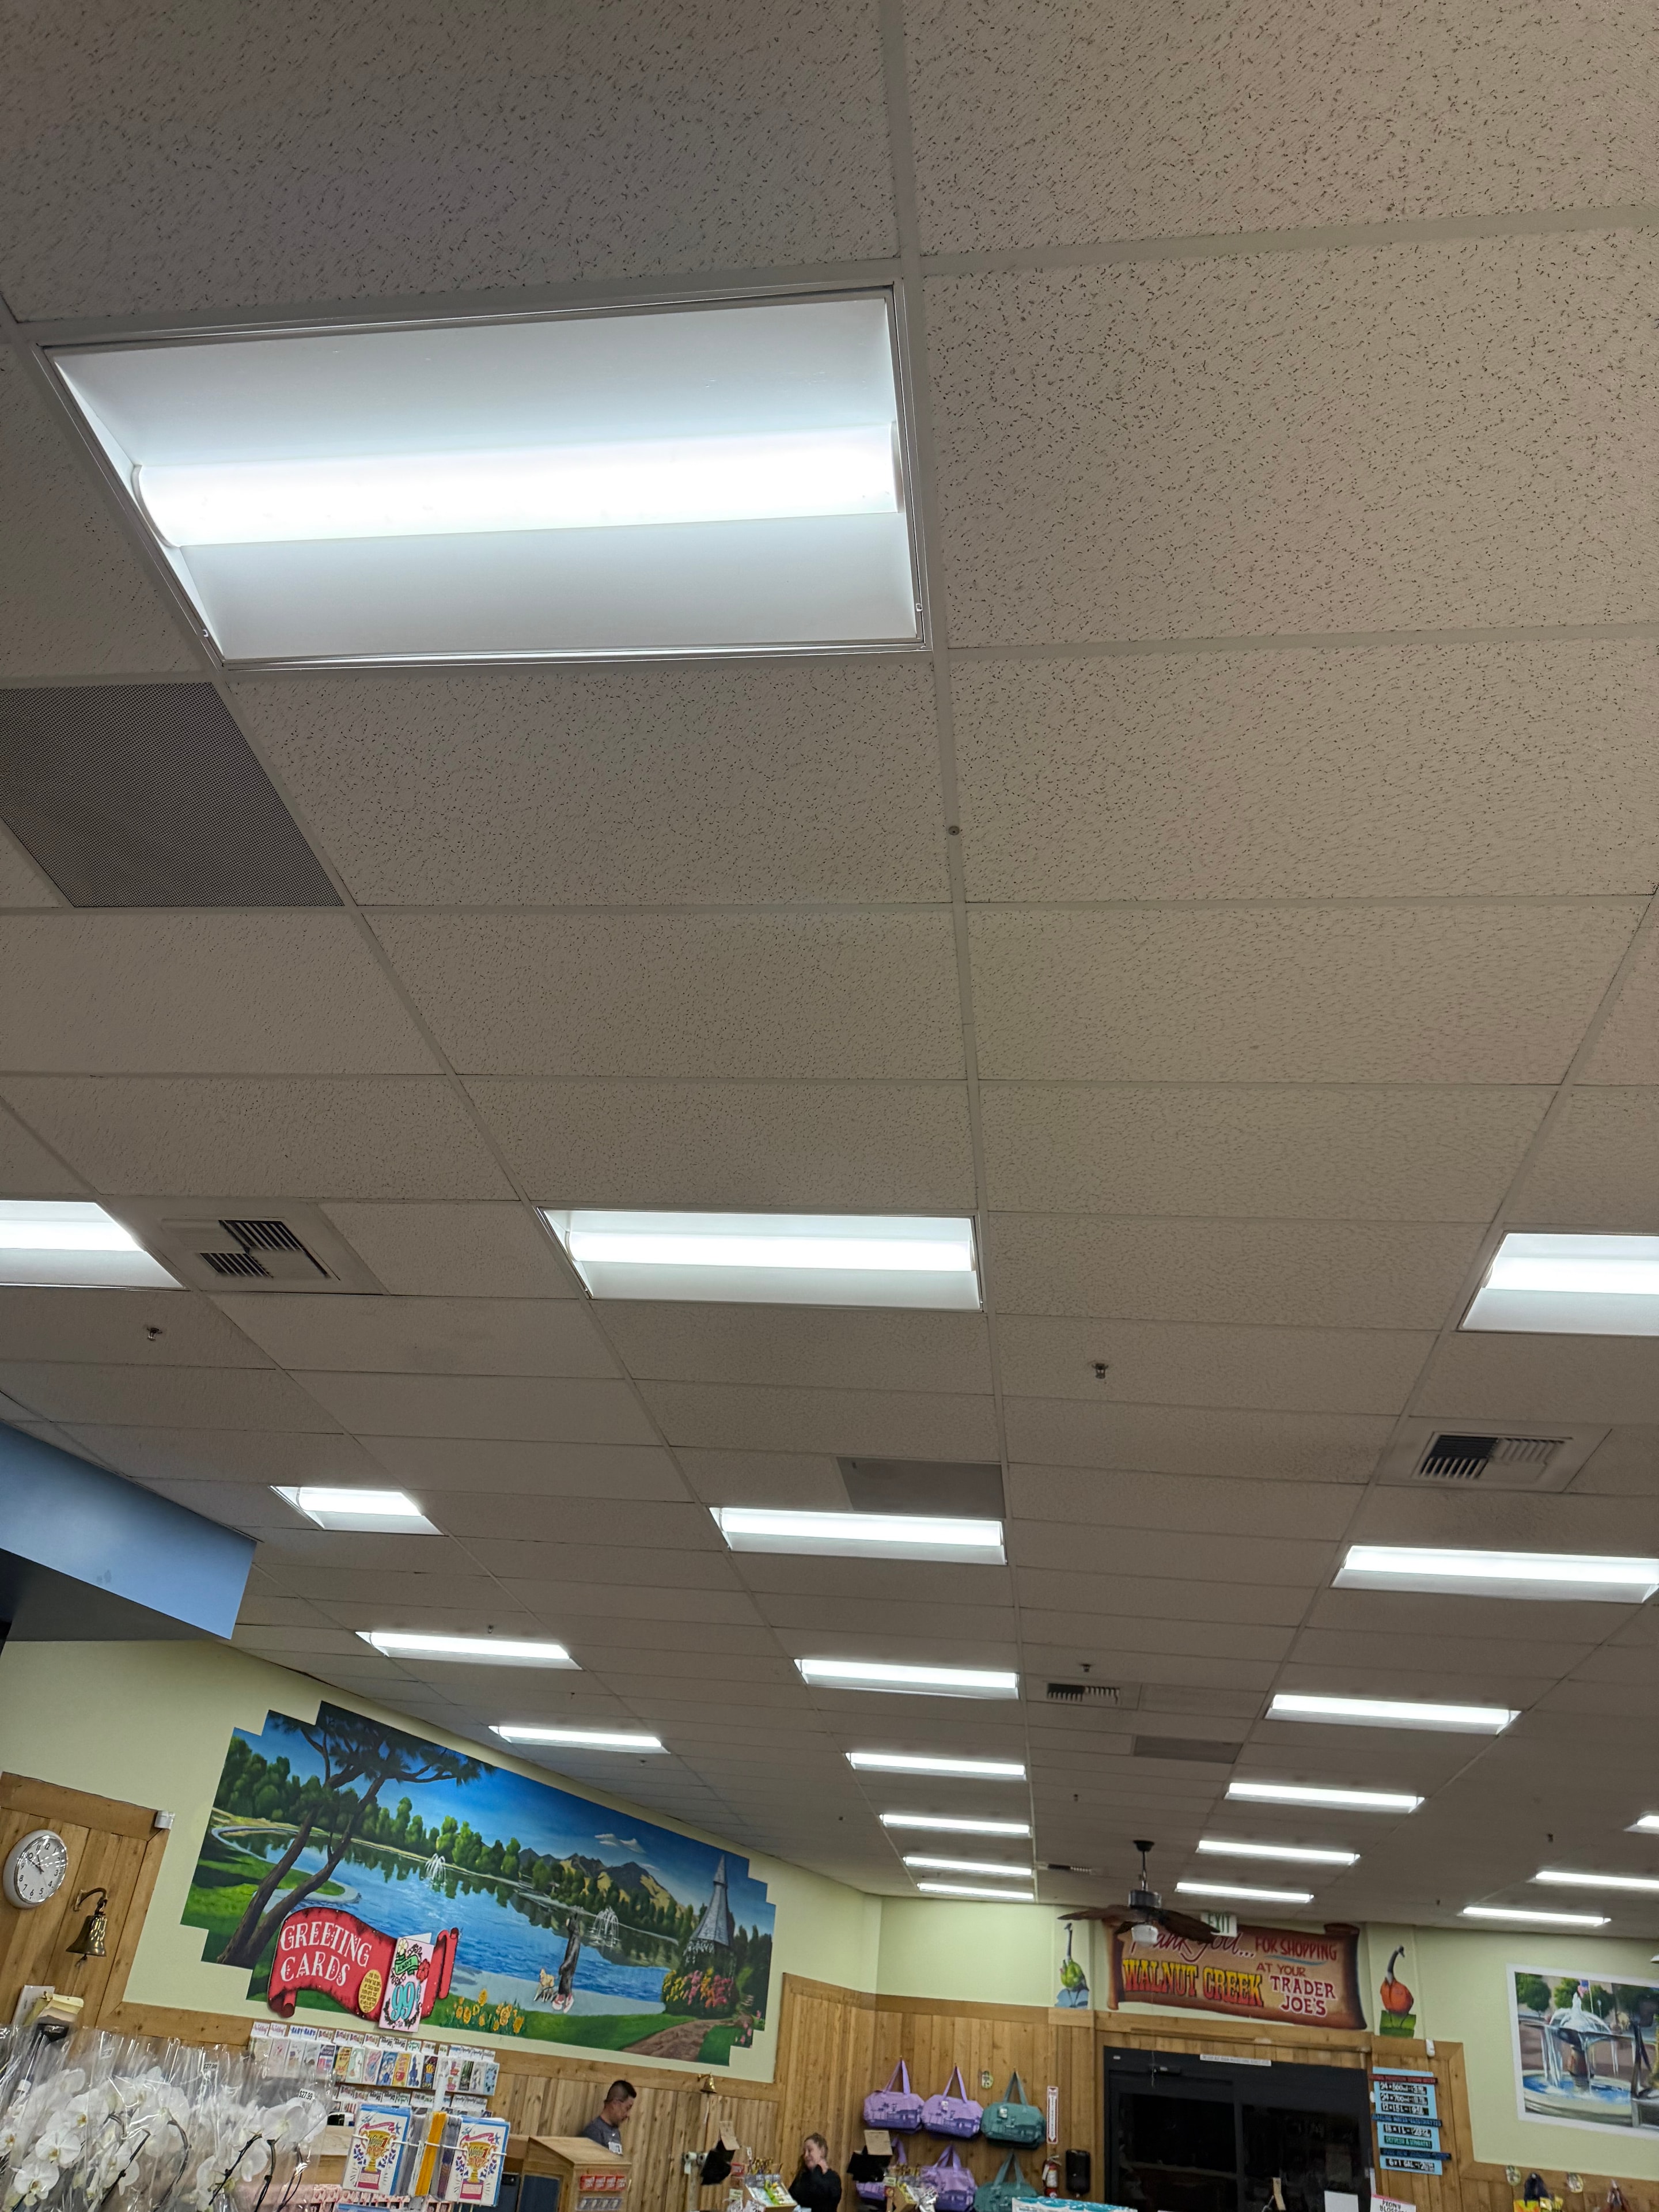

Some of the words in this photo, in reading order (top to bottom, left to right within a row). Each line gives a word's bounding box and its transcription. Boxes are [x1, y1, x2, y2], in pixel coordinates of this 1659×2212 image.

[23, 1884, 28, 1892] 7
[29, 1889, 34, 1897] 6
[280, 1921, 372, 1968] GREETING
[1280, 1938, 1337, 1961] SHOPPING
[280, 1951, 350, 1987] CARDS
[1256, 1962, 1272, 1973] AT
[1277, 1964, 1306, 1977] YOUR
[1123, 1959, 1199, 1997] WALNUT
[1202, 1968, 1264, 2008] CREEK
[1270, 1975, 1336, 1999] TRADER
[1281, 1995, 1326, 2016] JOE'S
[298, 2090, 313, 2101] $27.99
[1382, 2200, 1401, 2210] PEONY
